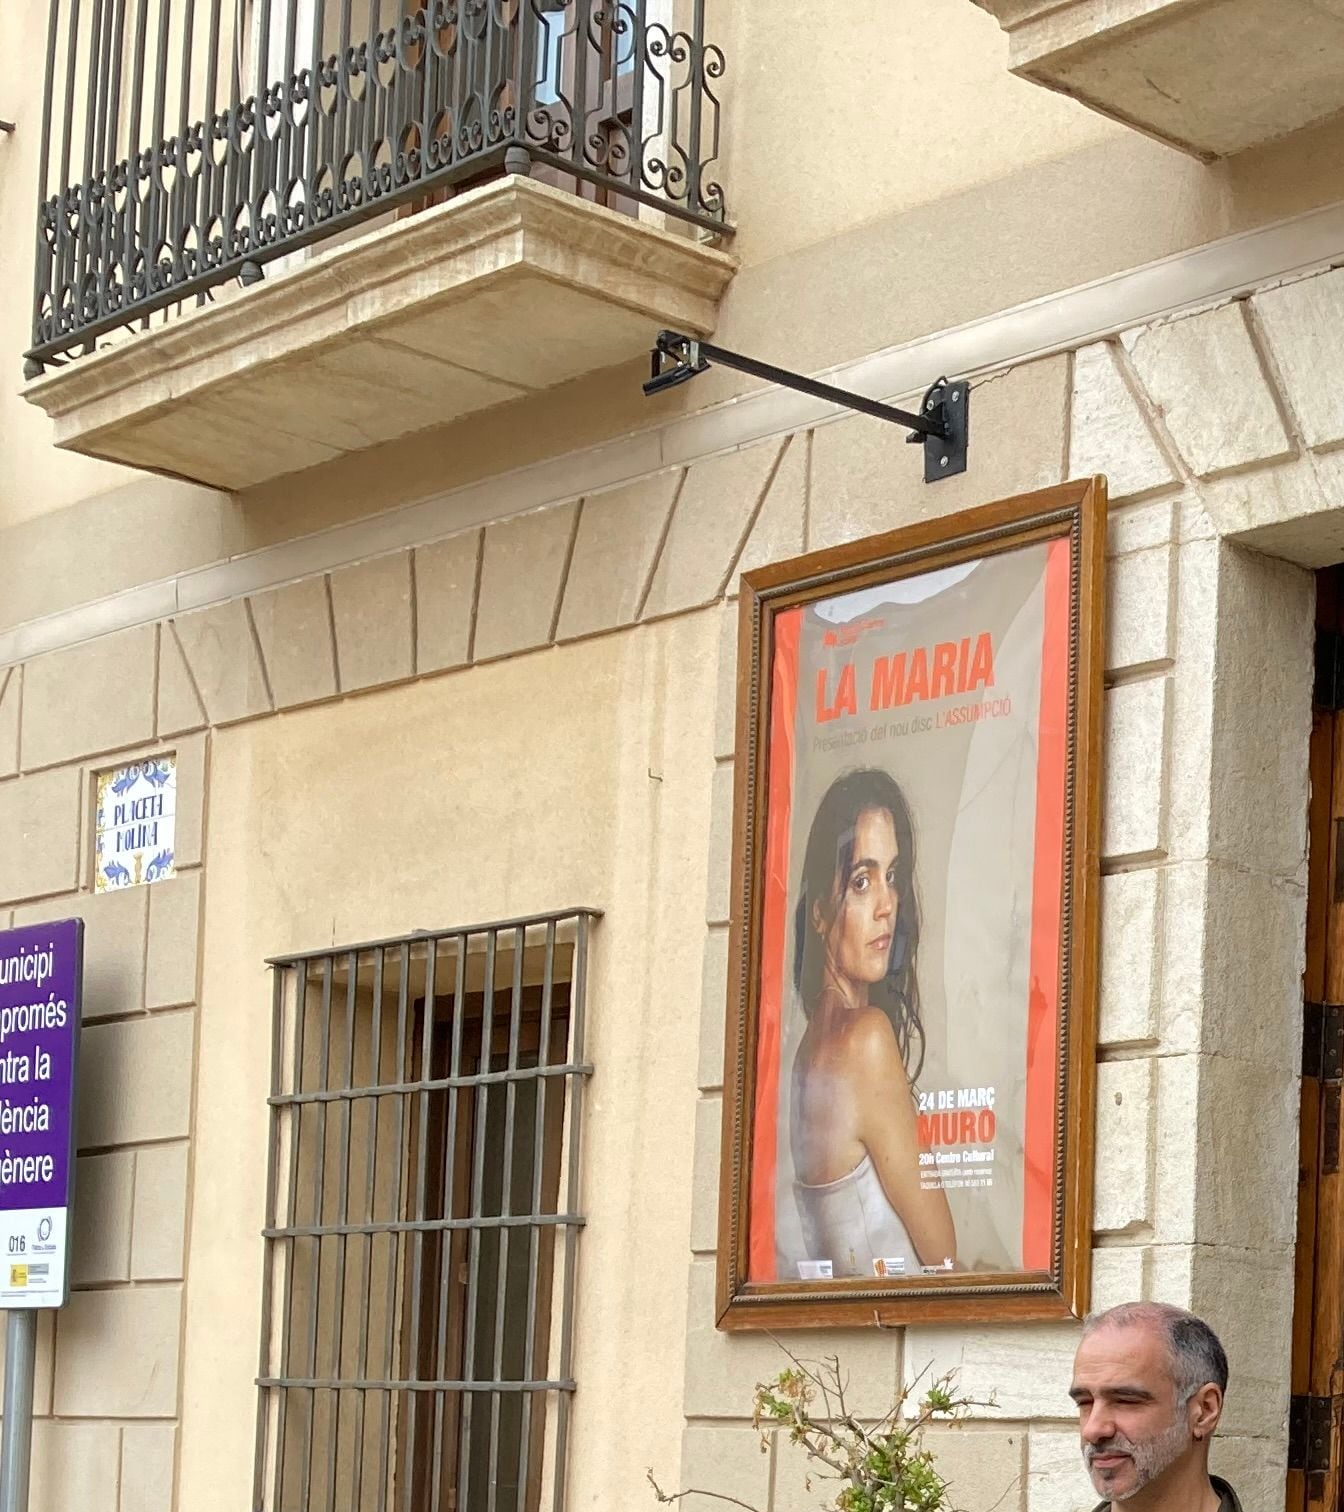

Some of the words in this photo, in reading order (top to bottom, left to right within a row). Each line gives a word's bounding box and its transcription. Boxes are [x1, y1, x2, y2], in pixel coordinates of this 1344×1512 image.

[816, 663, 857, 725] LA
[870, 632, 995, 712] MARIA
[870, 723, 888, 742] del
[889, 721, 909, 738] nou
[911, 714, 933, 735] disc
[114, 793, 163, 826] PLACETA
[0, 943, 53, 988] unicipi
[0, 993, 67, 1043] promés
[0, 1050, 29, 1084] ntra
[34, 1046, 50, 1080] la
[0, 1097, 49, 1134] ència
[919, 1092, 935, 1111] 24
[938, 1090, 954, 1109] DE
[958, 1087, 995, 1111] MARÇ
[917, 1109, 996, 1147] MURO
[0, 1149, 53, 1184] ènere
[919, 1153, 934, 1165] 20h
[936, 1152, 960, 1163] Centre
[963, 1149, 995, 1162] Cultural
[9, 1235, 26, 1252] 016
